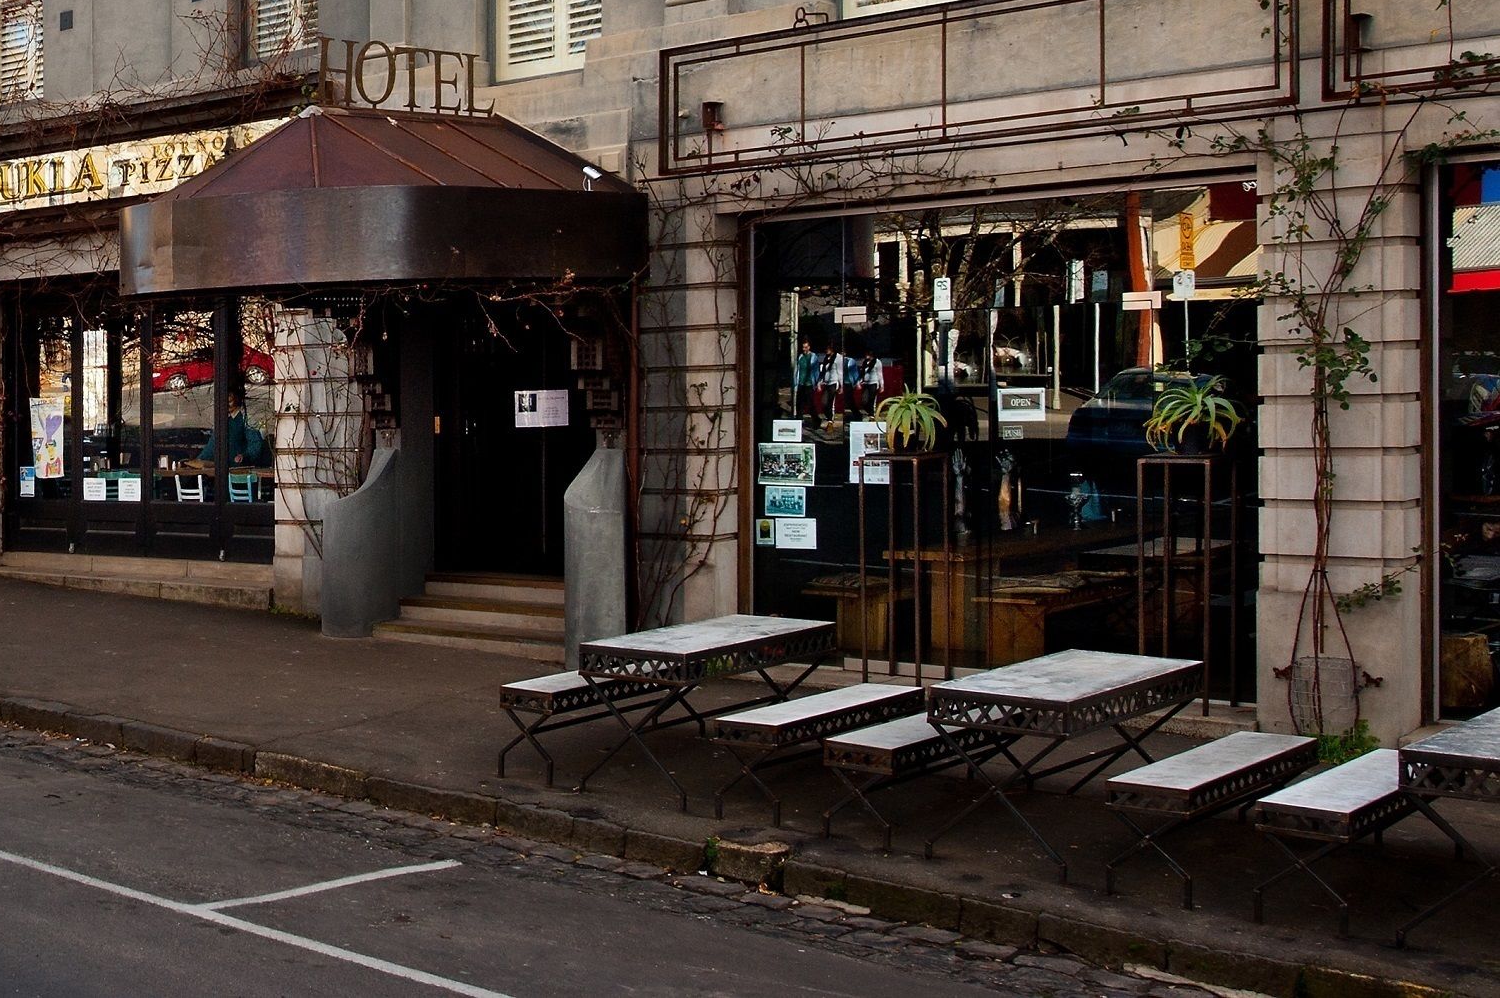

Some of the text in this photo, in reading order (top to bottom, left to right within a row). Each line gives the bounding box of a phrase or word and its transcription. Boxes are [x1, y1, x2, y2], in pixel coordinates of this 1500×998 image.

[318, 36, 496, 114] HOTEL
[120, 151, 217, 186] PIZZA
[1010, 398, 1031, 406] OPEN
